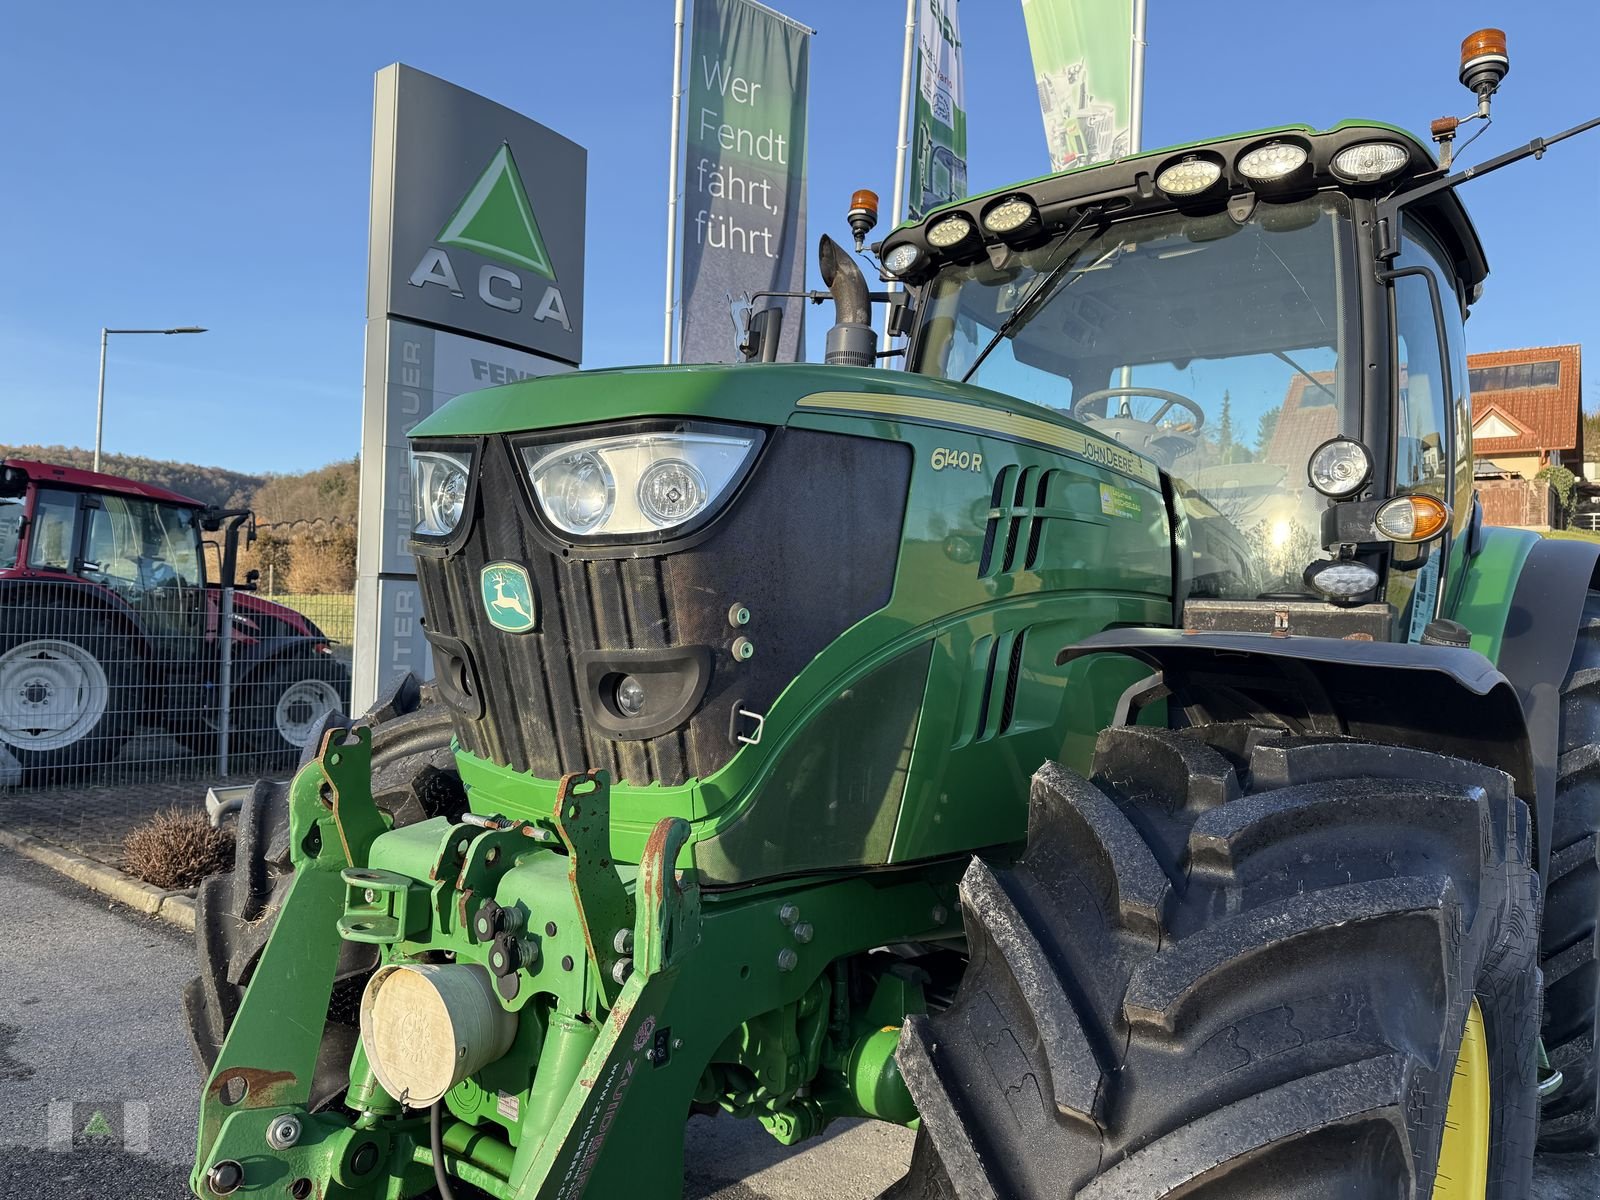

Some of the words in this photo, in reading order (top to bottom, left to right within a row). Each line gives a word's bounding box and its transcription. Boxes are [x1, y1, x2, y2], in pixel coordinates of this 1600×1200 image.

[702, 54, 762, 106] Wer
[699, 107, 787, 165] Fendt
[697, 158, 778, 216] fährt,
[694, 211, 780, 260] führt.
[408, 247, 573, 333] ACA
[470, 358, 537, 385] FEN
